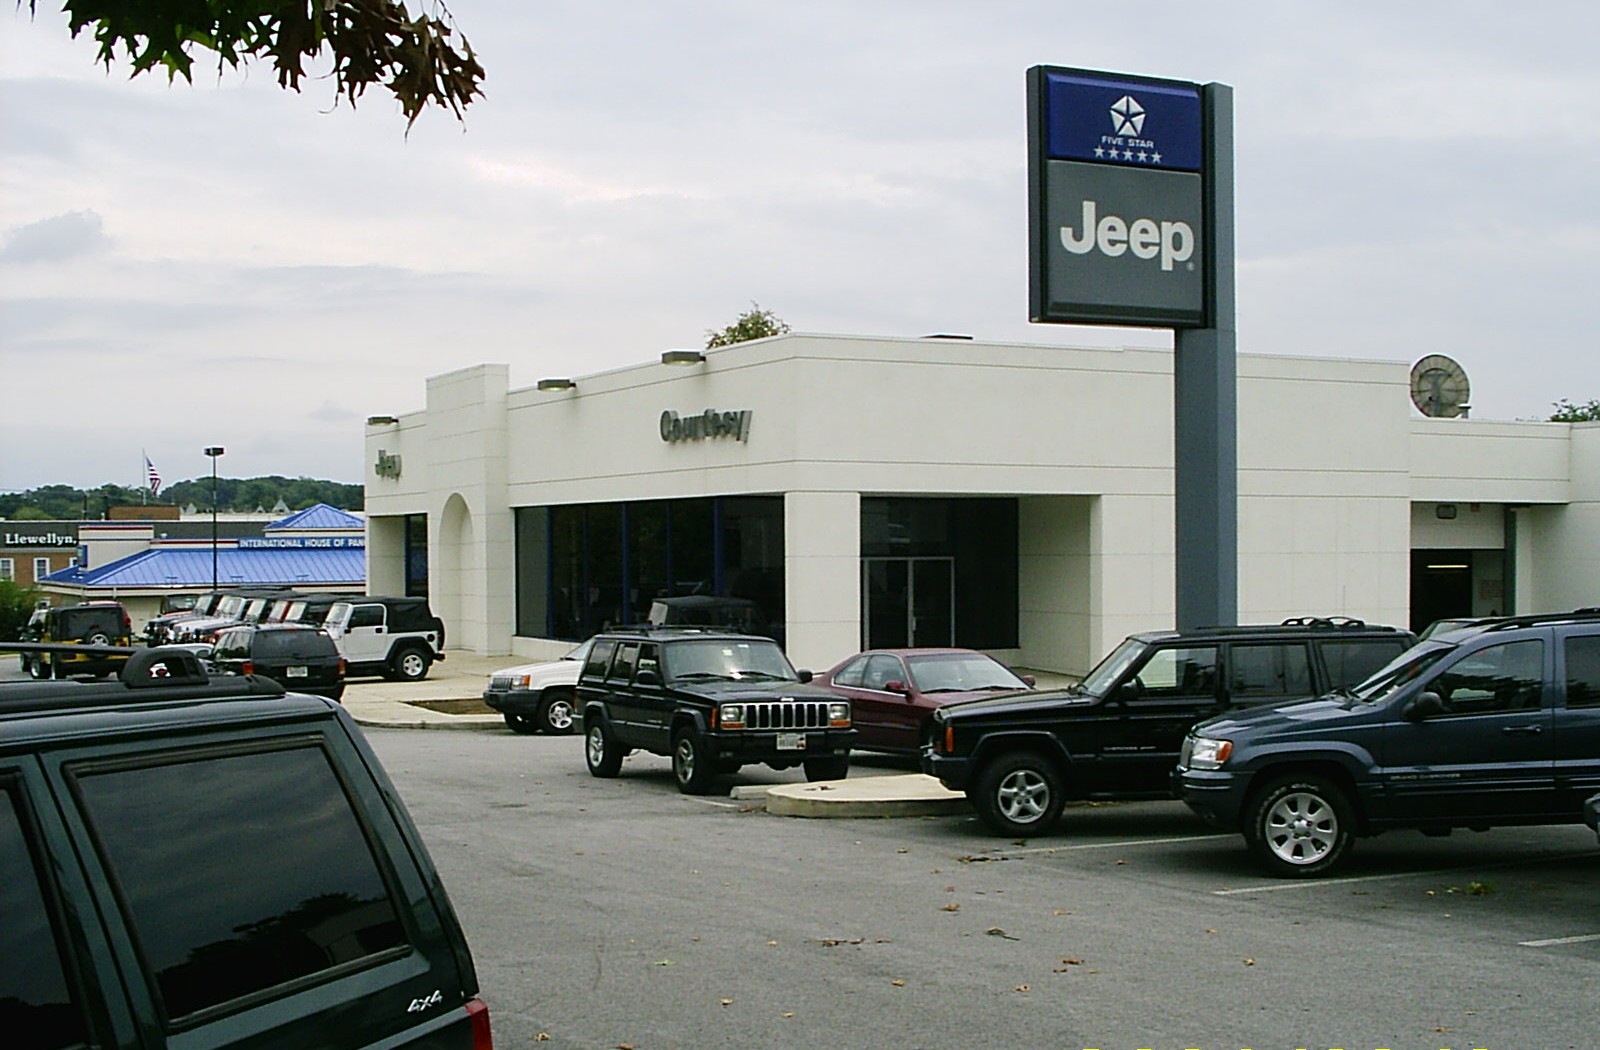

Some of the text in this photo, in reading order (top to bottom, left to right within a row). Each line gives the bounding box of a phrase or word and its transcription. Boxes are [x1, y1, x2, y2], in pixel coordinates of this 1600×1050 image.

[1101, 135, 1154, 149] FIVE STAR
[1060, 200, 1195, 271] Jeep
[239, 538, 303, 548] INTERNATIONAL
[304, 538, 331, 548] HOUSE
[334, 538, 345, 548] OF
